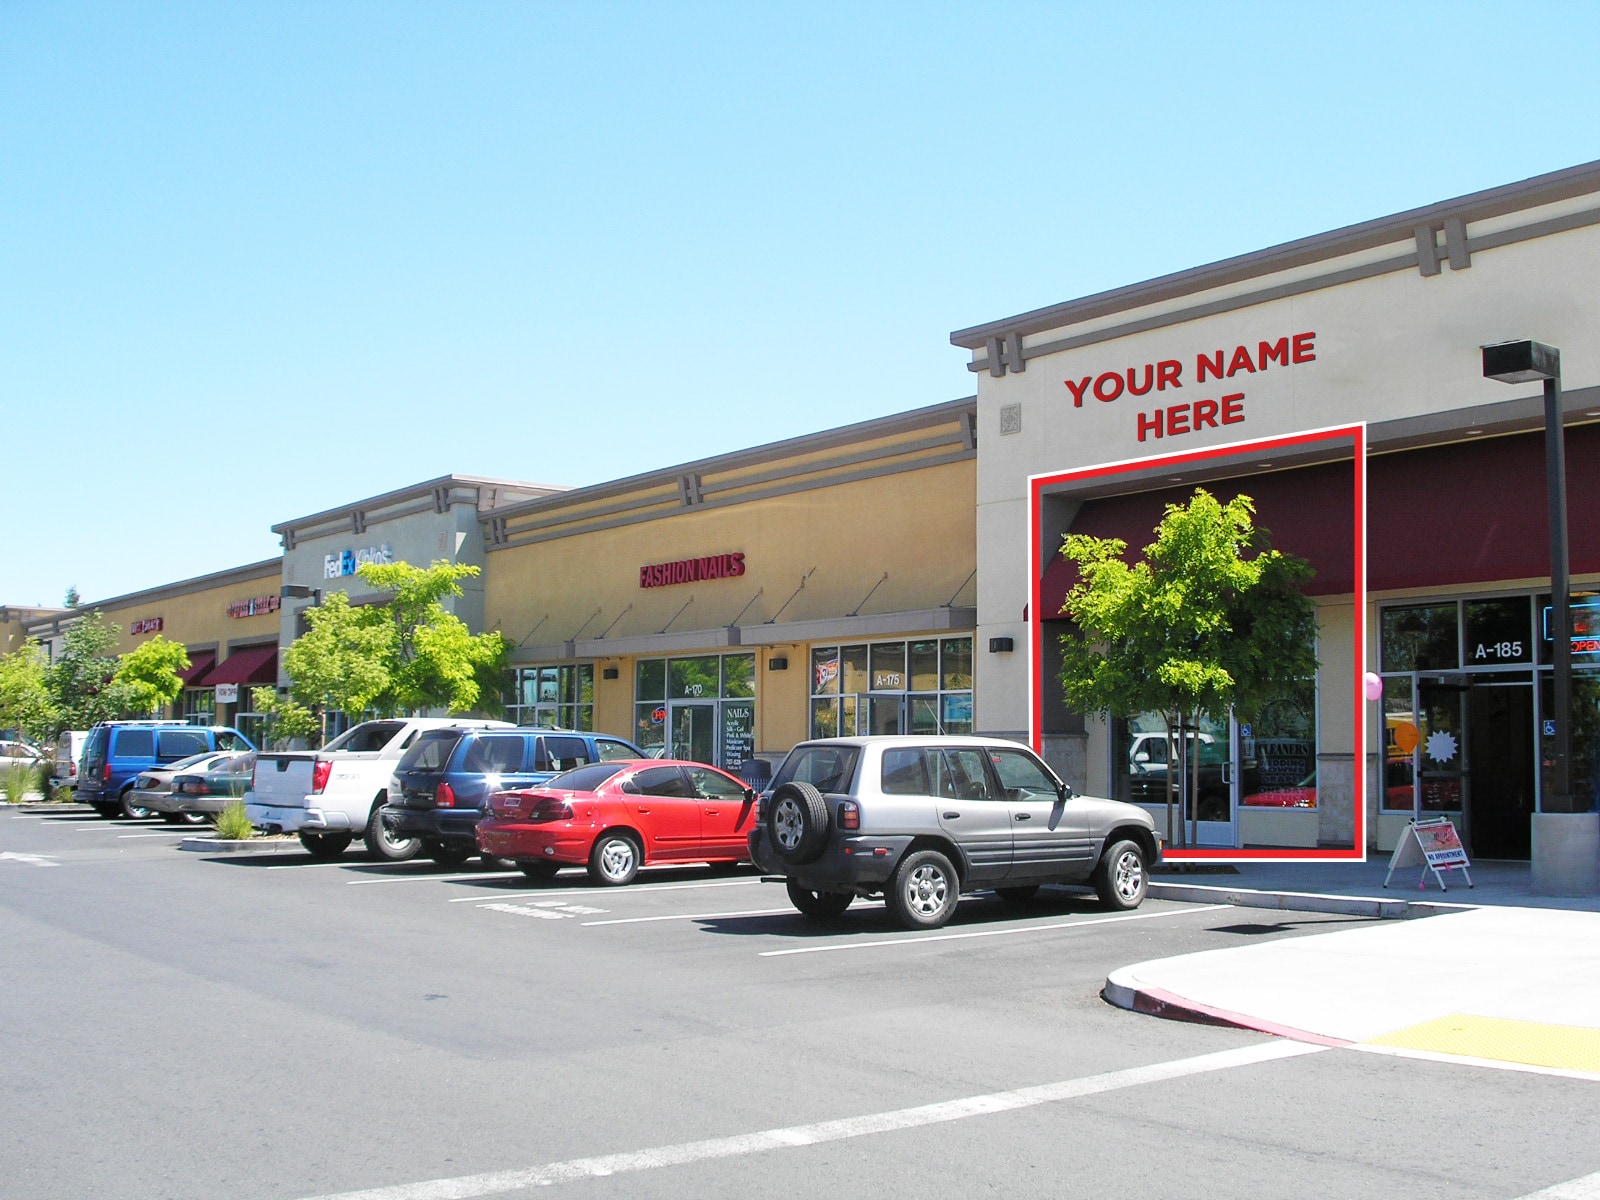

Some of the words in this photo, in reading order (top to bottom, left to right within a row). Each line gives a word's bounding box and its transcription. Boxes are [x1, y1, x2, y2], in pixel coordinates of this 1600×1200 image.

[324, 550, 355, 579] FedEx
[640, 559, 695, 588] FASHION
[698, 553, 745, 582] NAILS
[1475, 641, 1523, 658] A-185
[1570, 640, 1600, 652] OPEN
[876, 673, 900, 686] A-175
[684, 684, 703, 696] A-170
[727, 708, 749, 718] NAILS
[1258, 743, 1309, 755] CLEANERS
[1259, 759, 1305, 767] WEDDING
[1259, 766, 1305, 774] GOWNS
[1261, 775, 1305, 784] DRAPES
[1258, 786, 1283, 794] ONE
[1427, 853, 1435, 861] NO
[1434, 850, 1464, 861] APPOINTMENT
